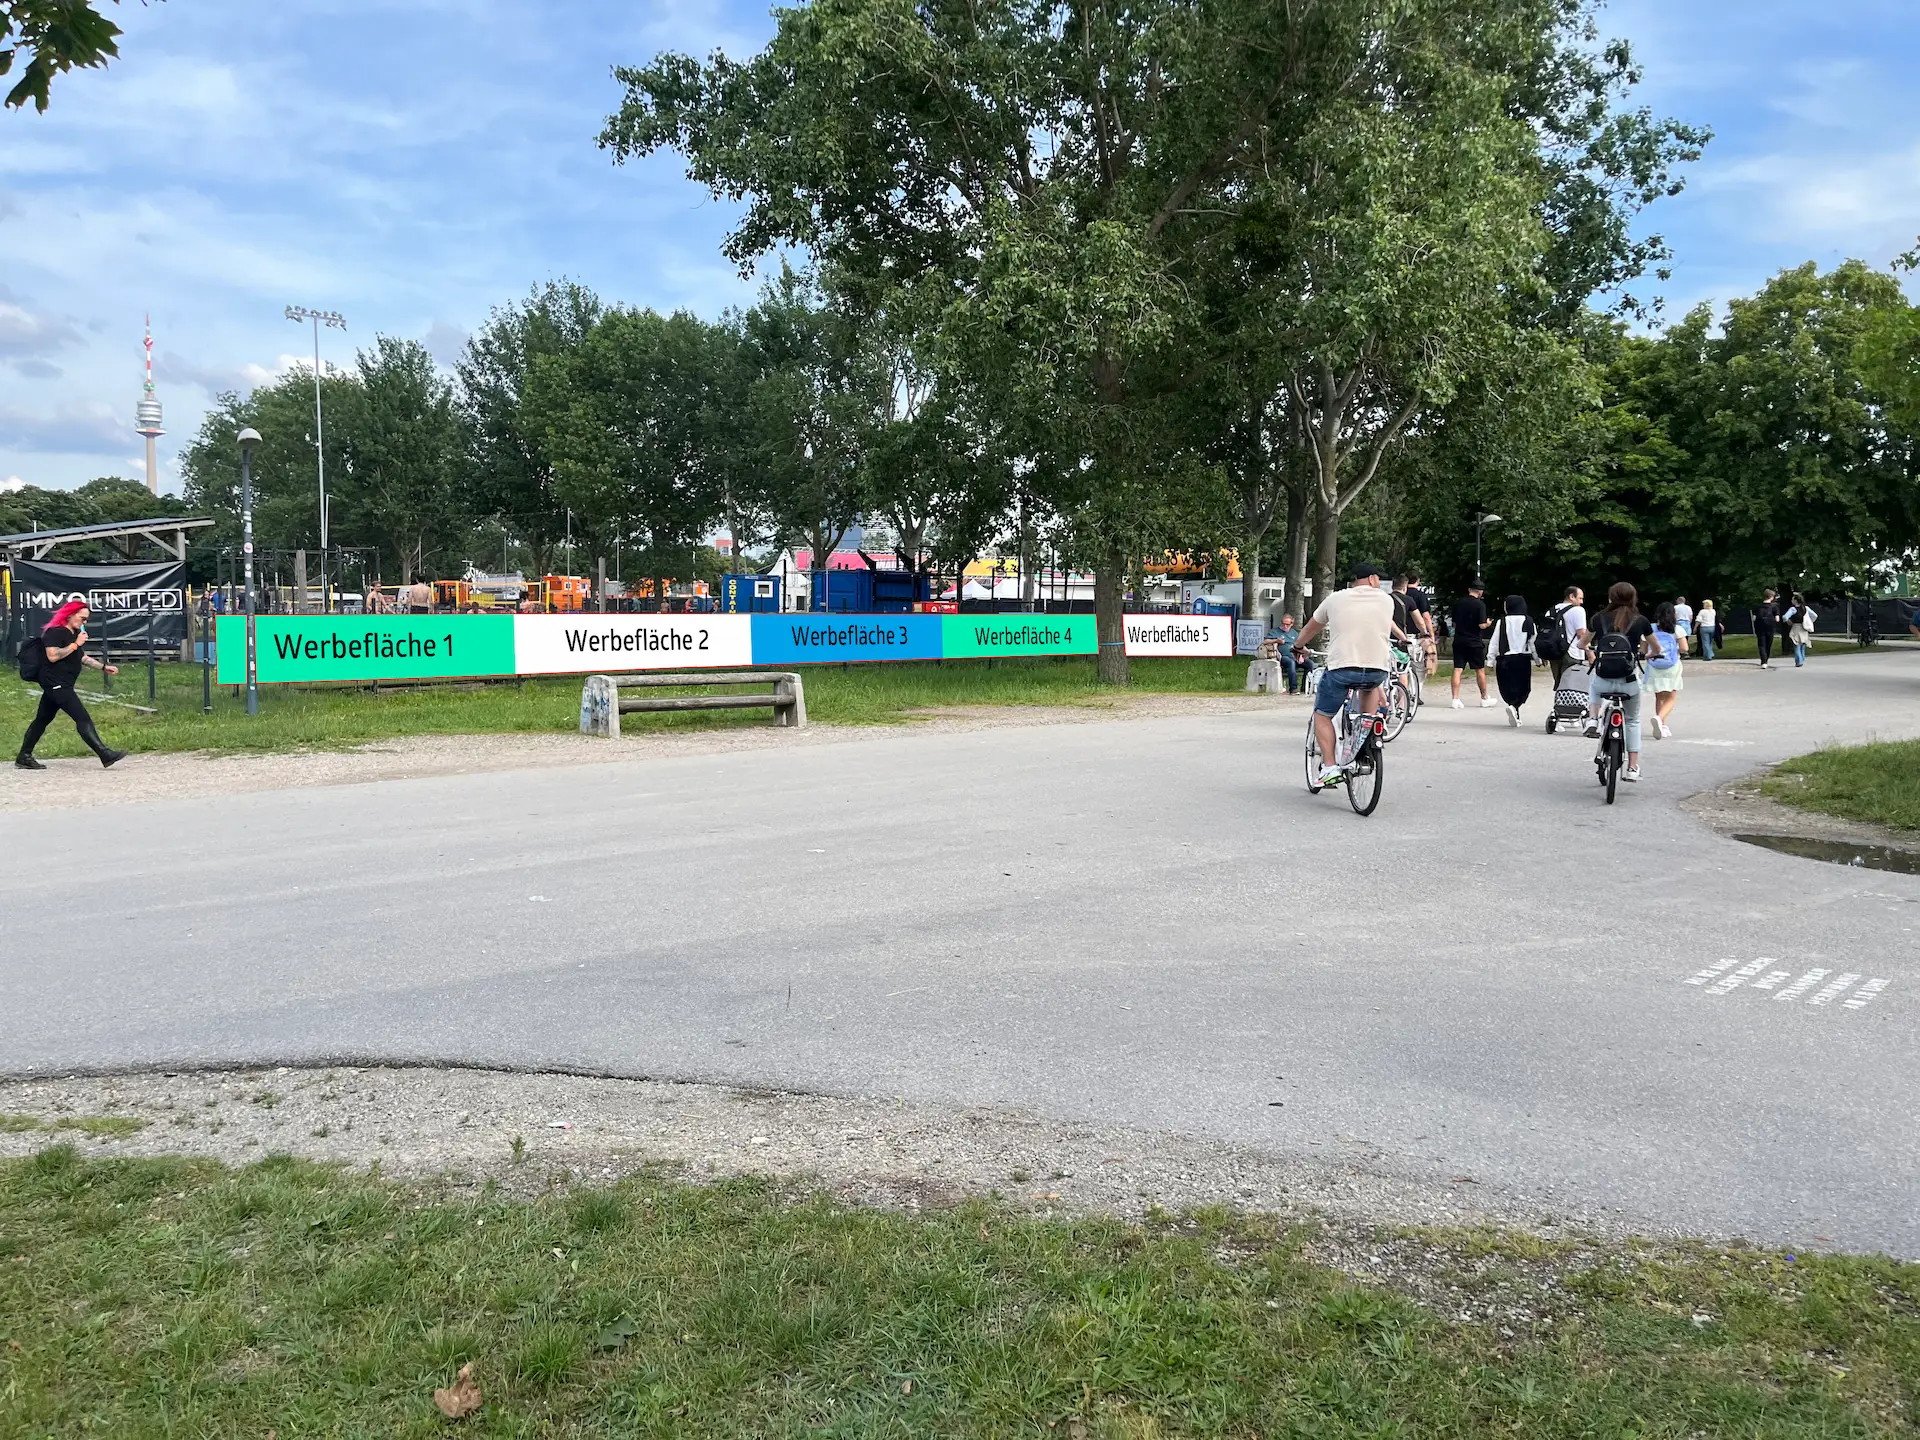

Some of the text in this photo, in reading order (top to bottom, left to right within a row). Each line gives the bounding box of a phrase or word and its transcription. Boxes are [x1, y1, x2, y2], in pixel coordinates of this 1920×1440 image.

[564, 628, 709, 652] Werbefläche 2
[791, 625, 908, 647] Werbefläche 3
[974, 626, 1073, 646] Werbefläche 4
[1127, 625, 1209, 643] Werbefläche 5
[1242, 628, 1260, 638] SUPER
[273, 632, 453, 660] Werbefläche 1
